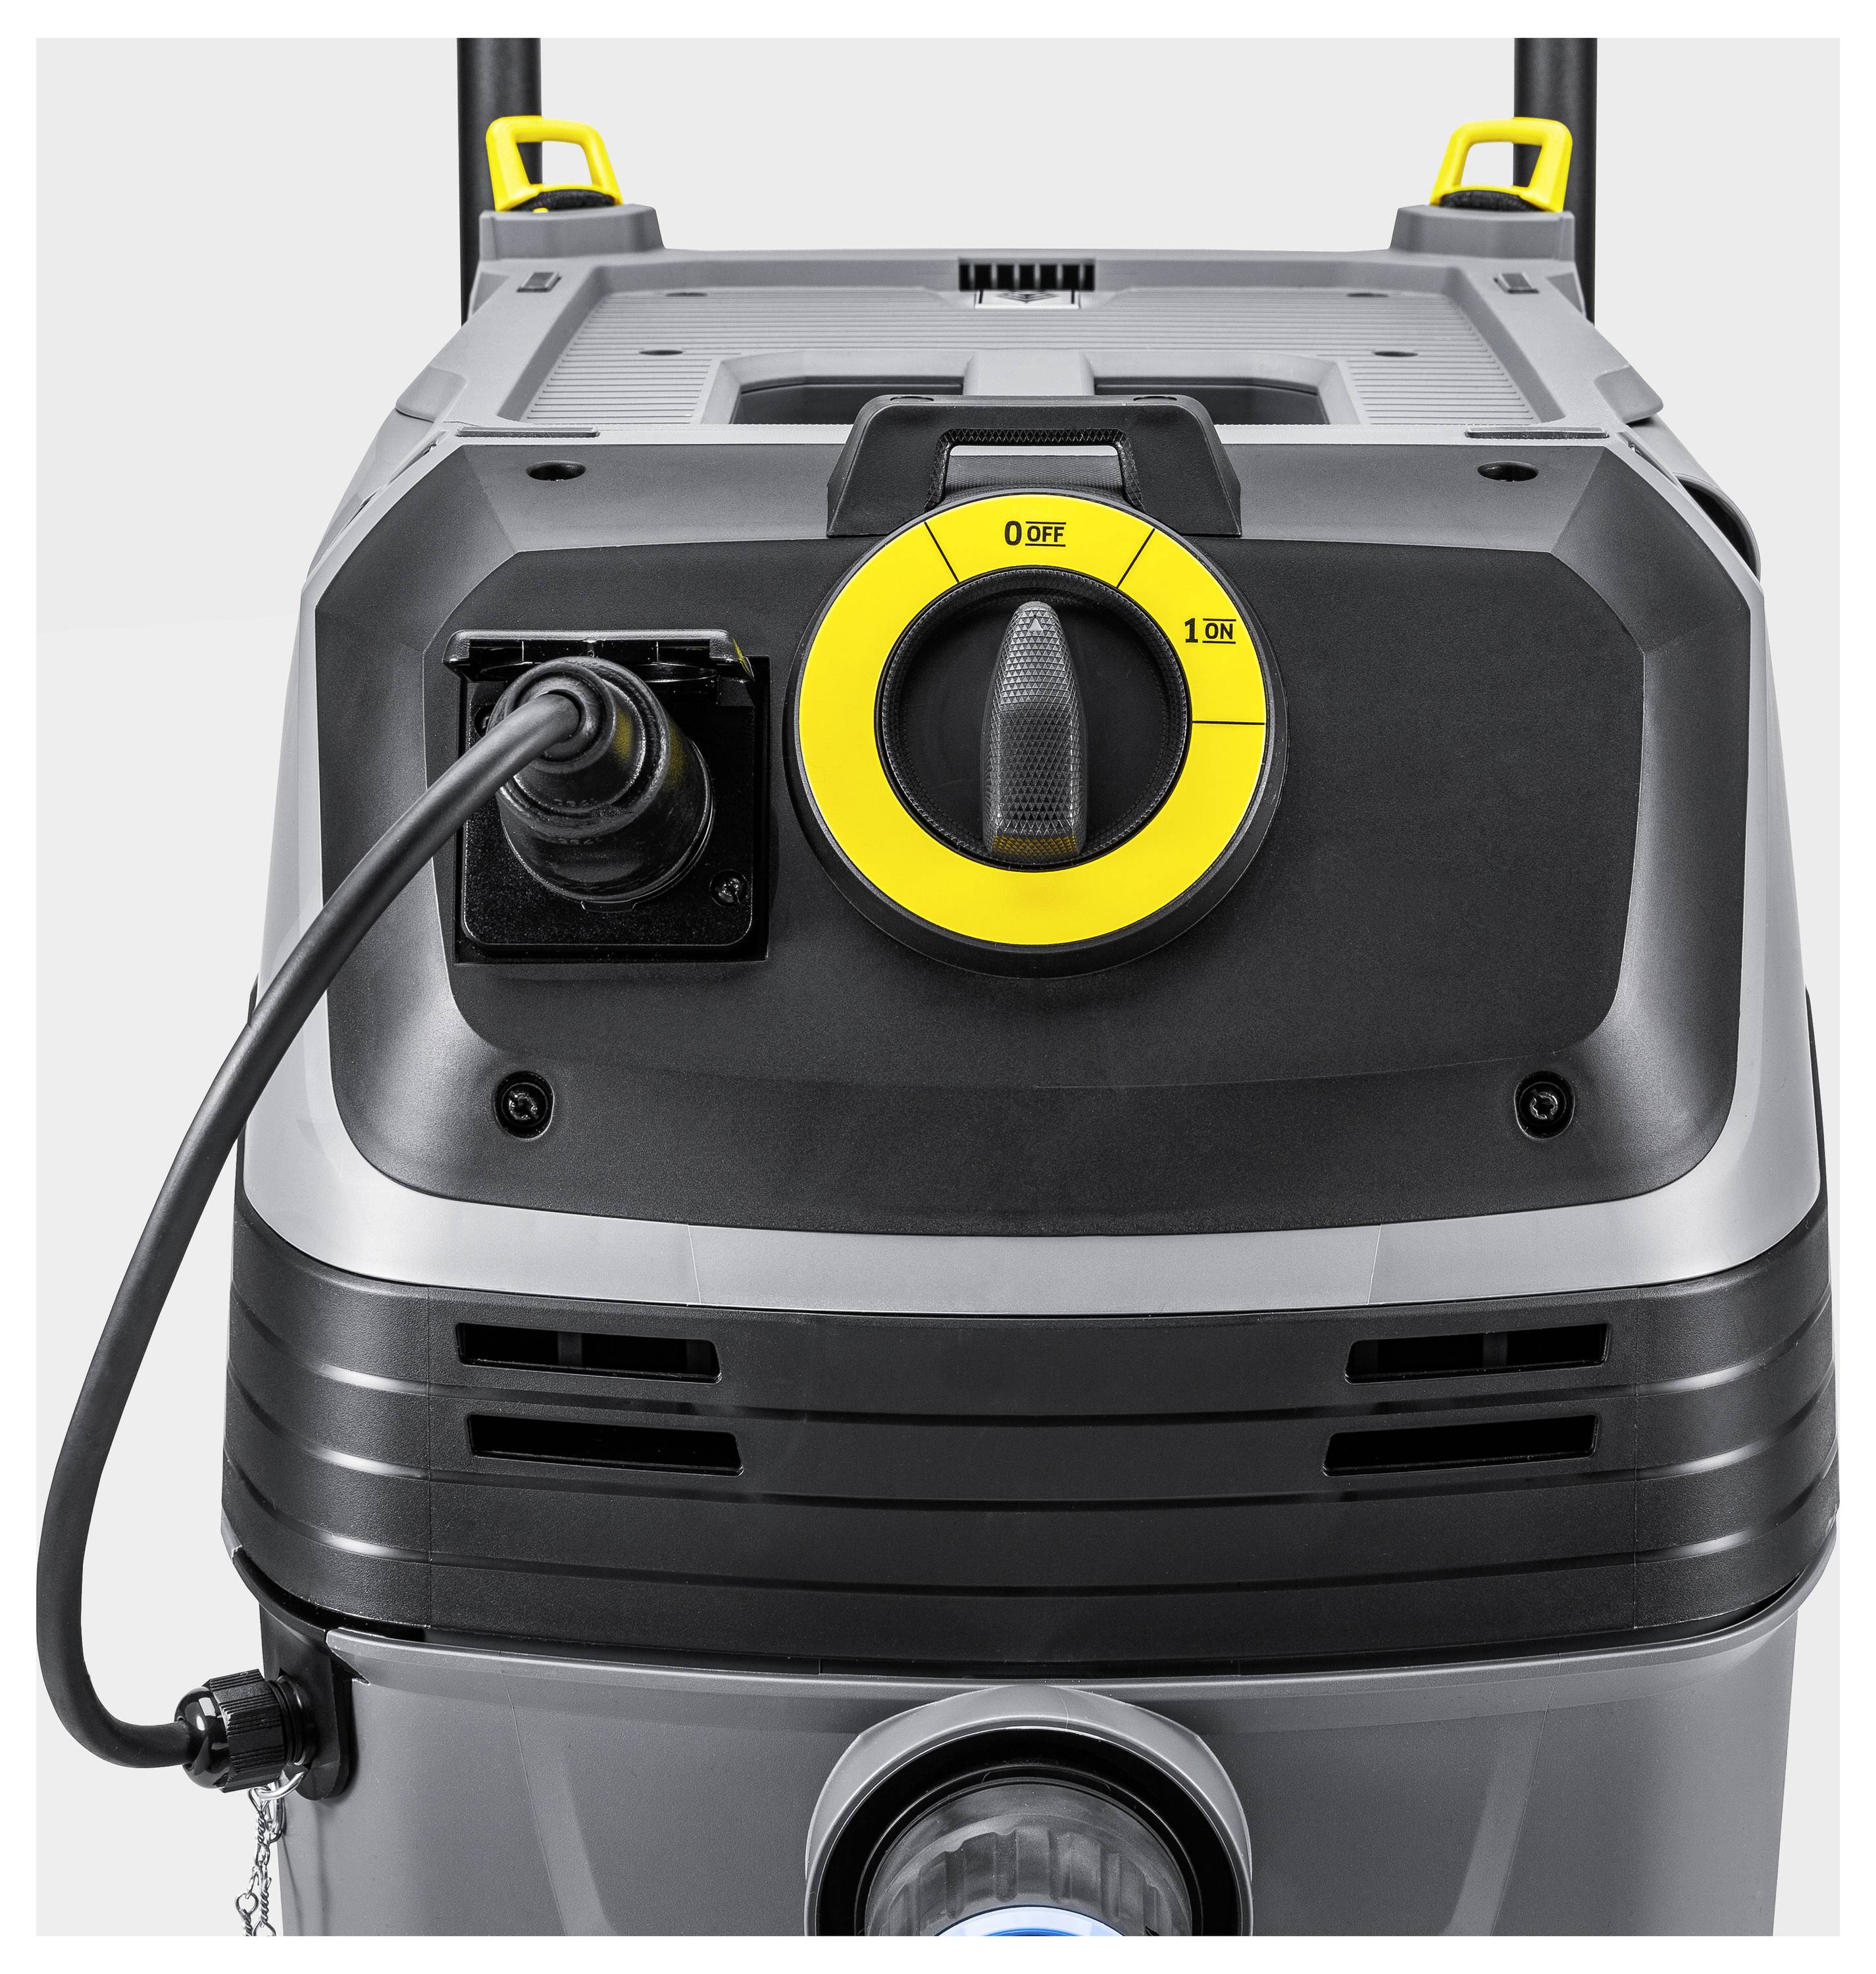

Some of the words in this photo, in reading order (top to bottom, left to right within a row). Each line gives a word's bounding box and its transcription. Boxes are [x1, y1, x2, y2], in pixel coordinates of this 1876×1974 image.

[1004, 520, 1023, 546] 0
[1027, 526, 1065, 543] OFF
[1184, 617, 1199, 644] 1
[1204, 622, 1234, 640] ON
